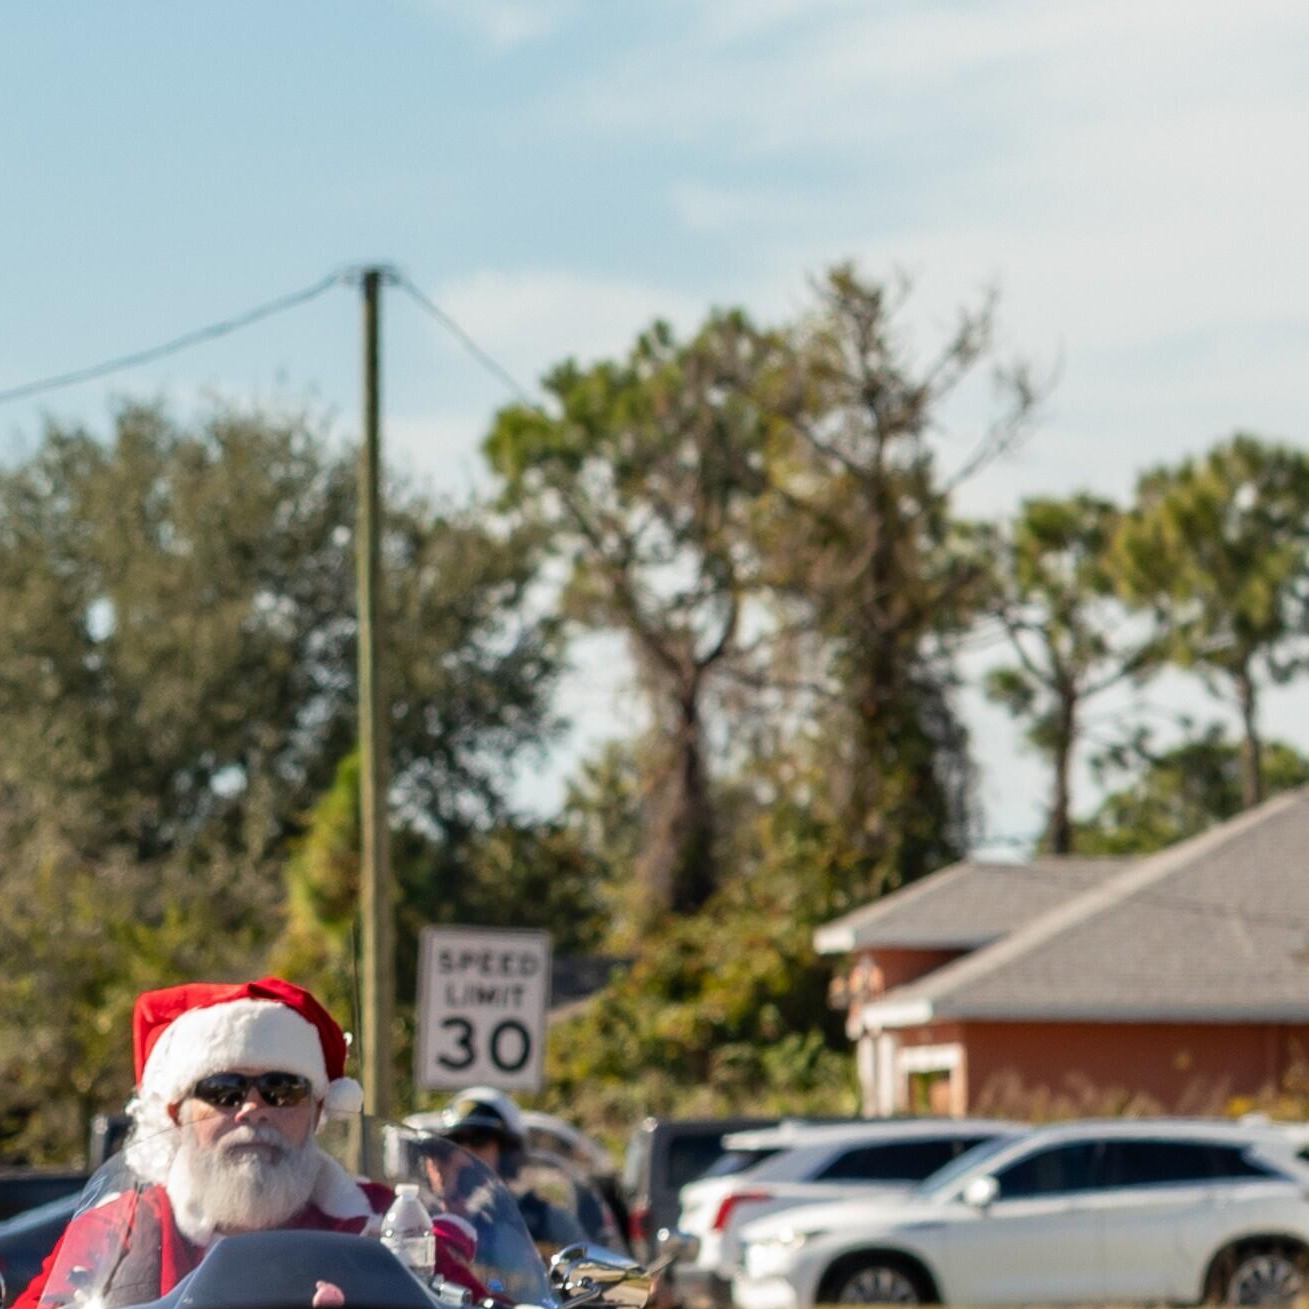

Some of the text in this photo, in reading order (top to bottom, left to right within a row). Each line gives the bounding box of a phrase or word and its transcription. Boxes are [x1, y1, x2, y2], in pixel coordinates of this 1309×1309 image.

[438, 949, 539, 977] SPEED
[444, 979, 525, 1007] LIMIT
[436, 1016, 532, 1074] 30
